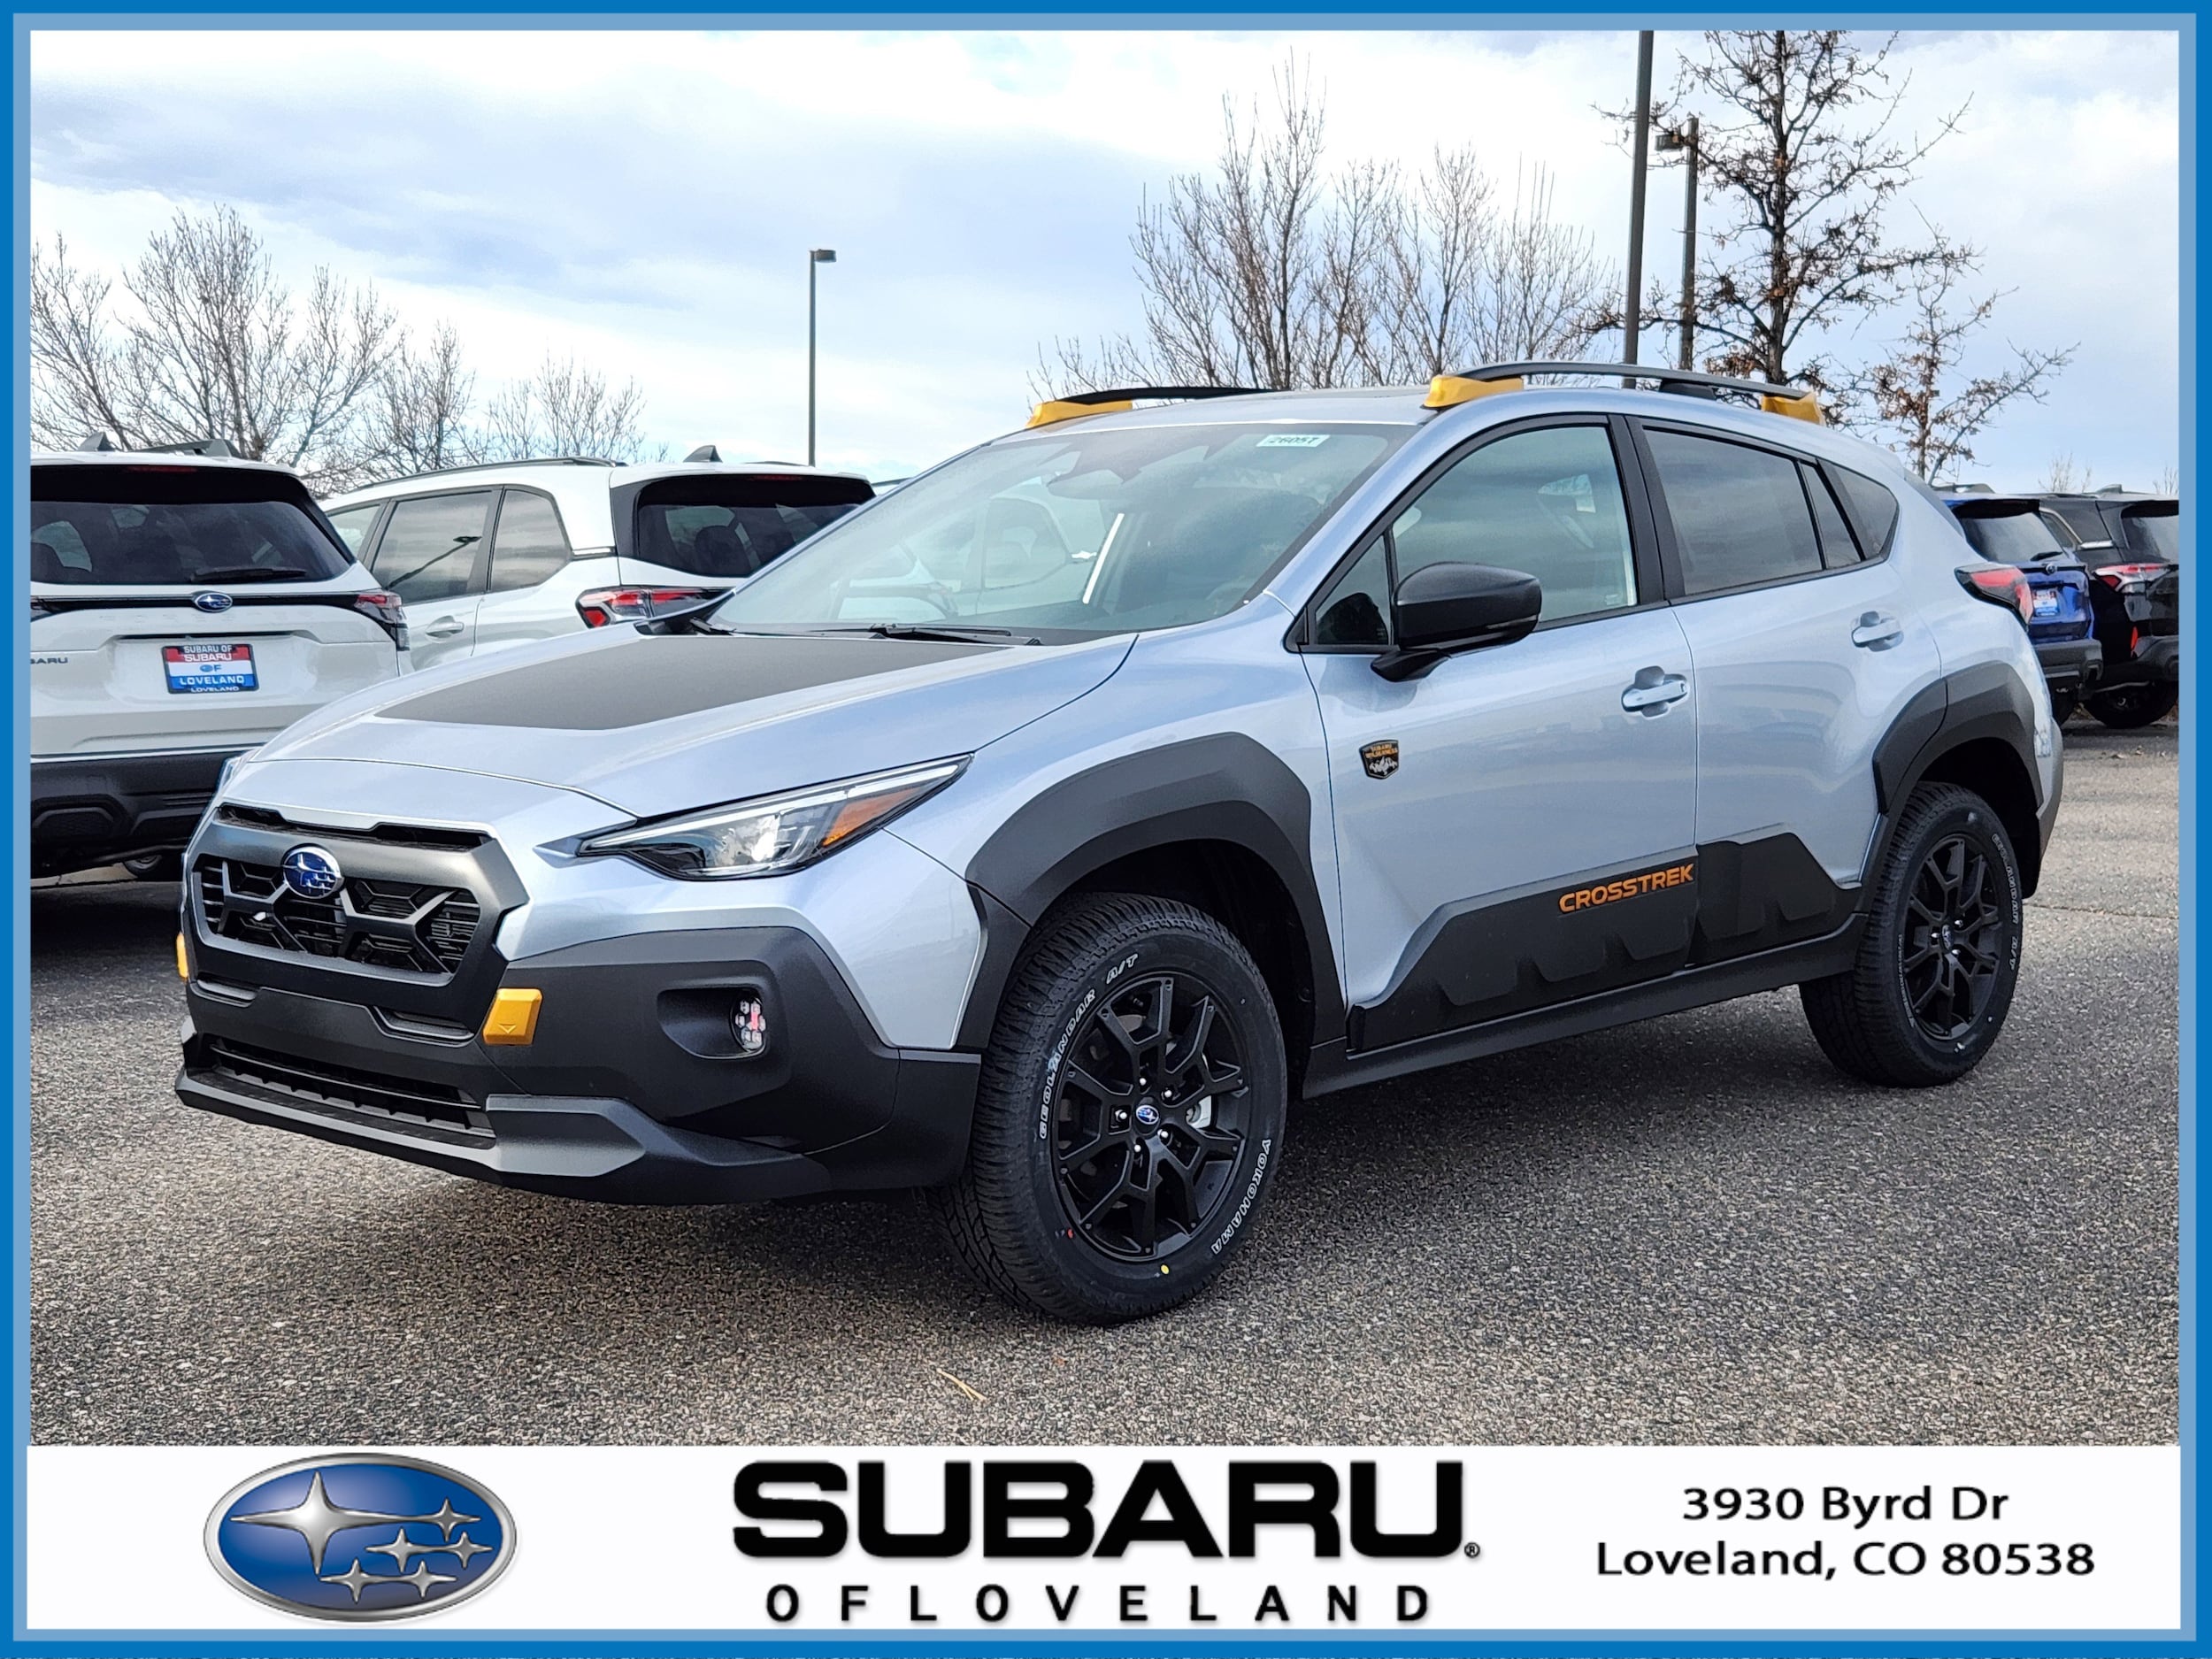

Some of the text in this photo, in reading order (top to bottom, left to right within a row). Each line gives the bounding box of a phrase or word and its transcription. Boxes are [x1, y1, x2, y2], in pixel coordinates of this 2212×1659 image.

[184, 645, 219, 654] SUBARU
[184, 653, 232, 662] SUBARU
[180, 676, 245, 685] LOVELAND
[1559, 864, 1694, 913] CROSSTREK
[1039, 954, 1139, 1140] GEOLANDAR A/T
[1211, 1139, 1271, 1255] YOKOHAMA
